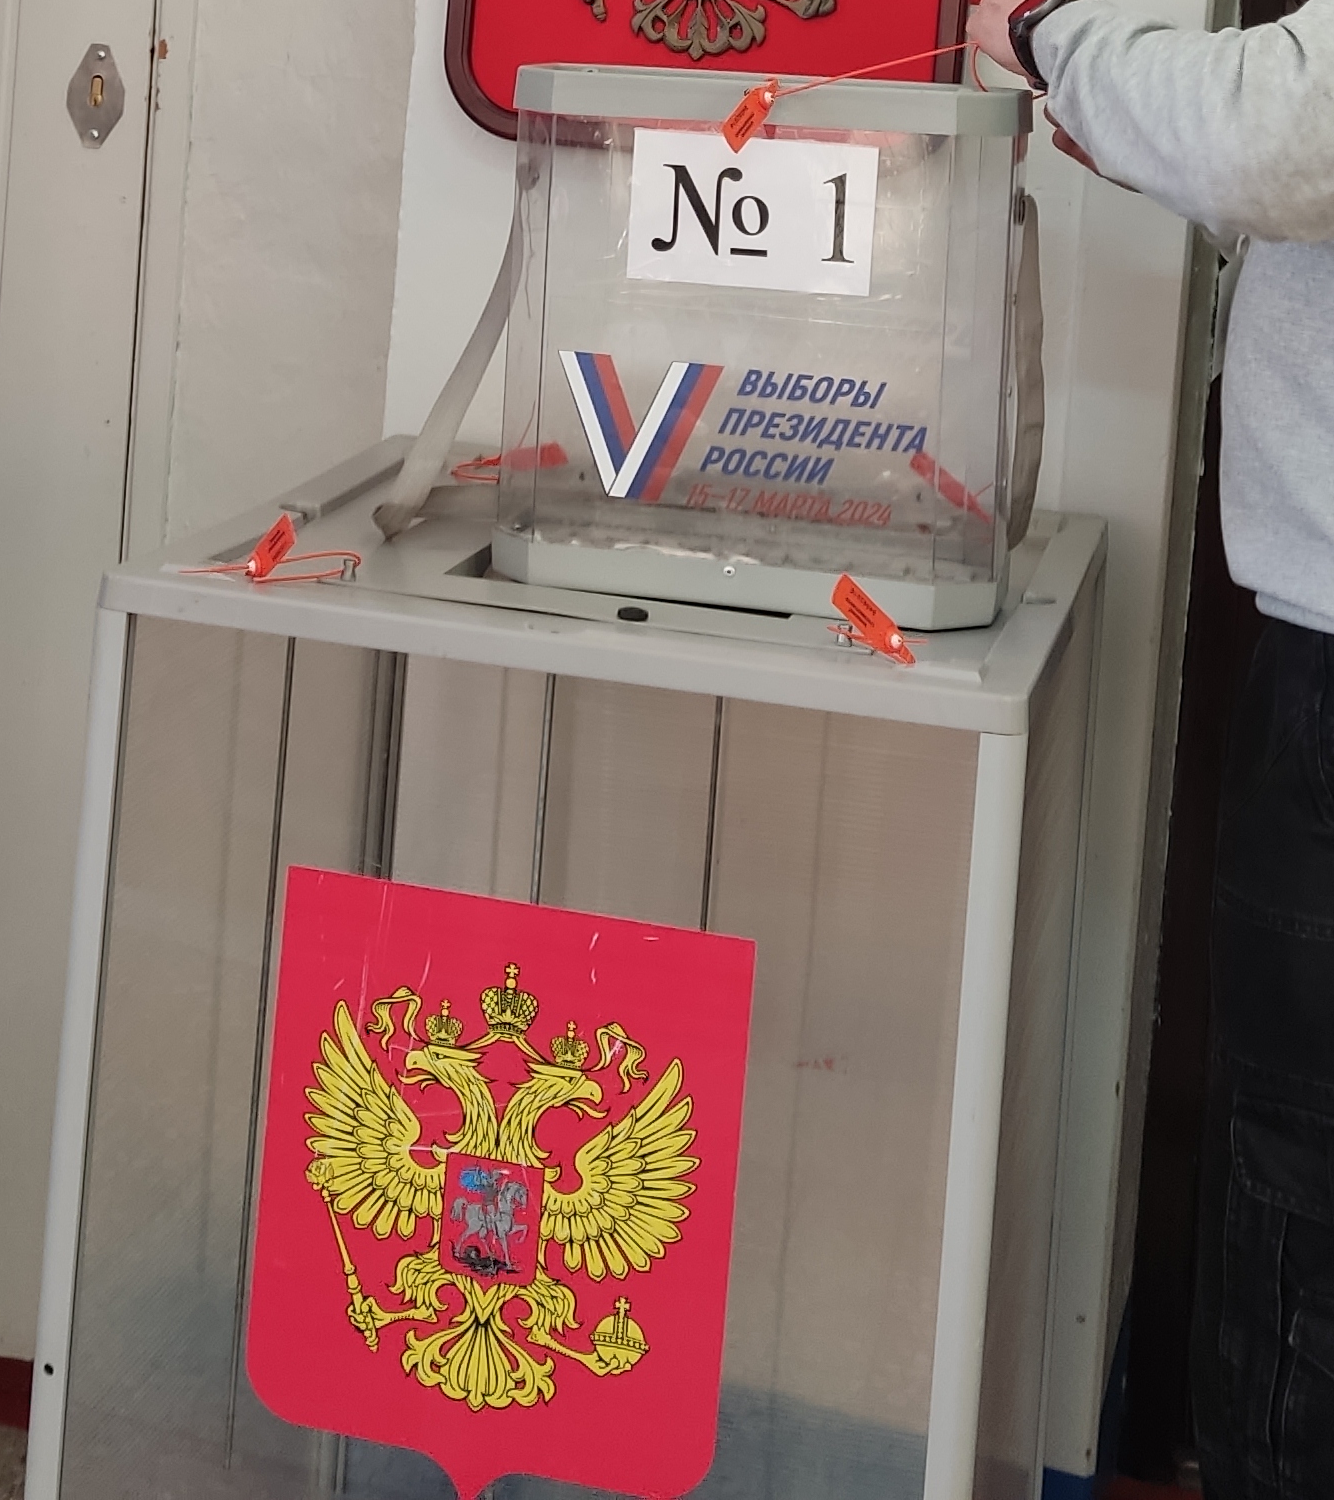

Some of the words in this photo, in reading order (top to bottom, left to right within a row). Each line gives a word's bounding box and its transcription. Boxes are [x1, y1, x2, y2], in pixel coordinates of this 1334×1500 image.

[822, 173, 855, 264] 1
[736, 369, 888, 410] ВЫБОРЫ
[718, 407, 929, 455] ПРЕЗИДЕНТА
[699, 445, 835, 486] РОССИИ
[752, 489, 832, 520] МАРТА
[834, 498, 892, 527] 2024
